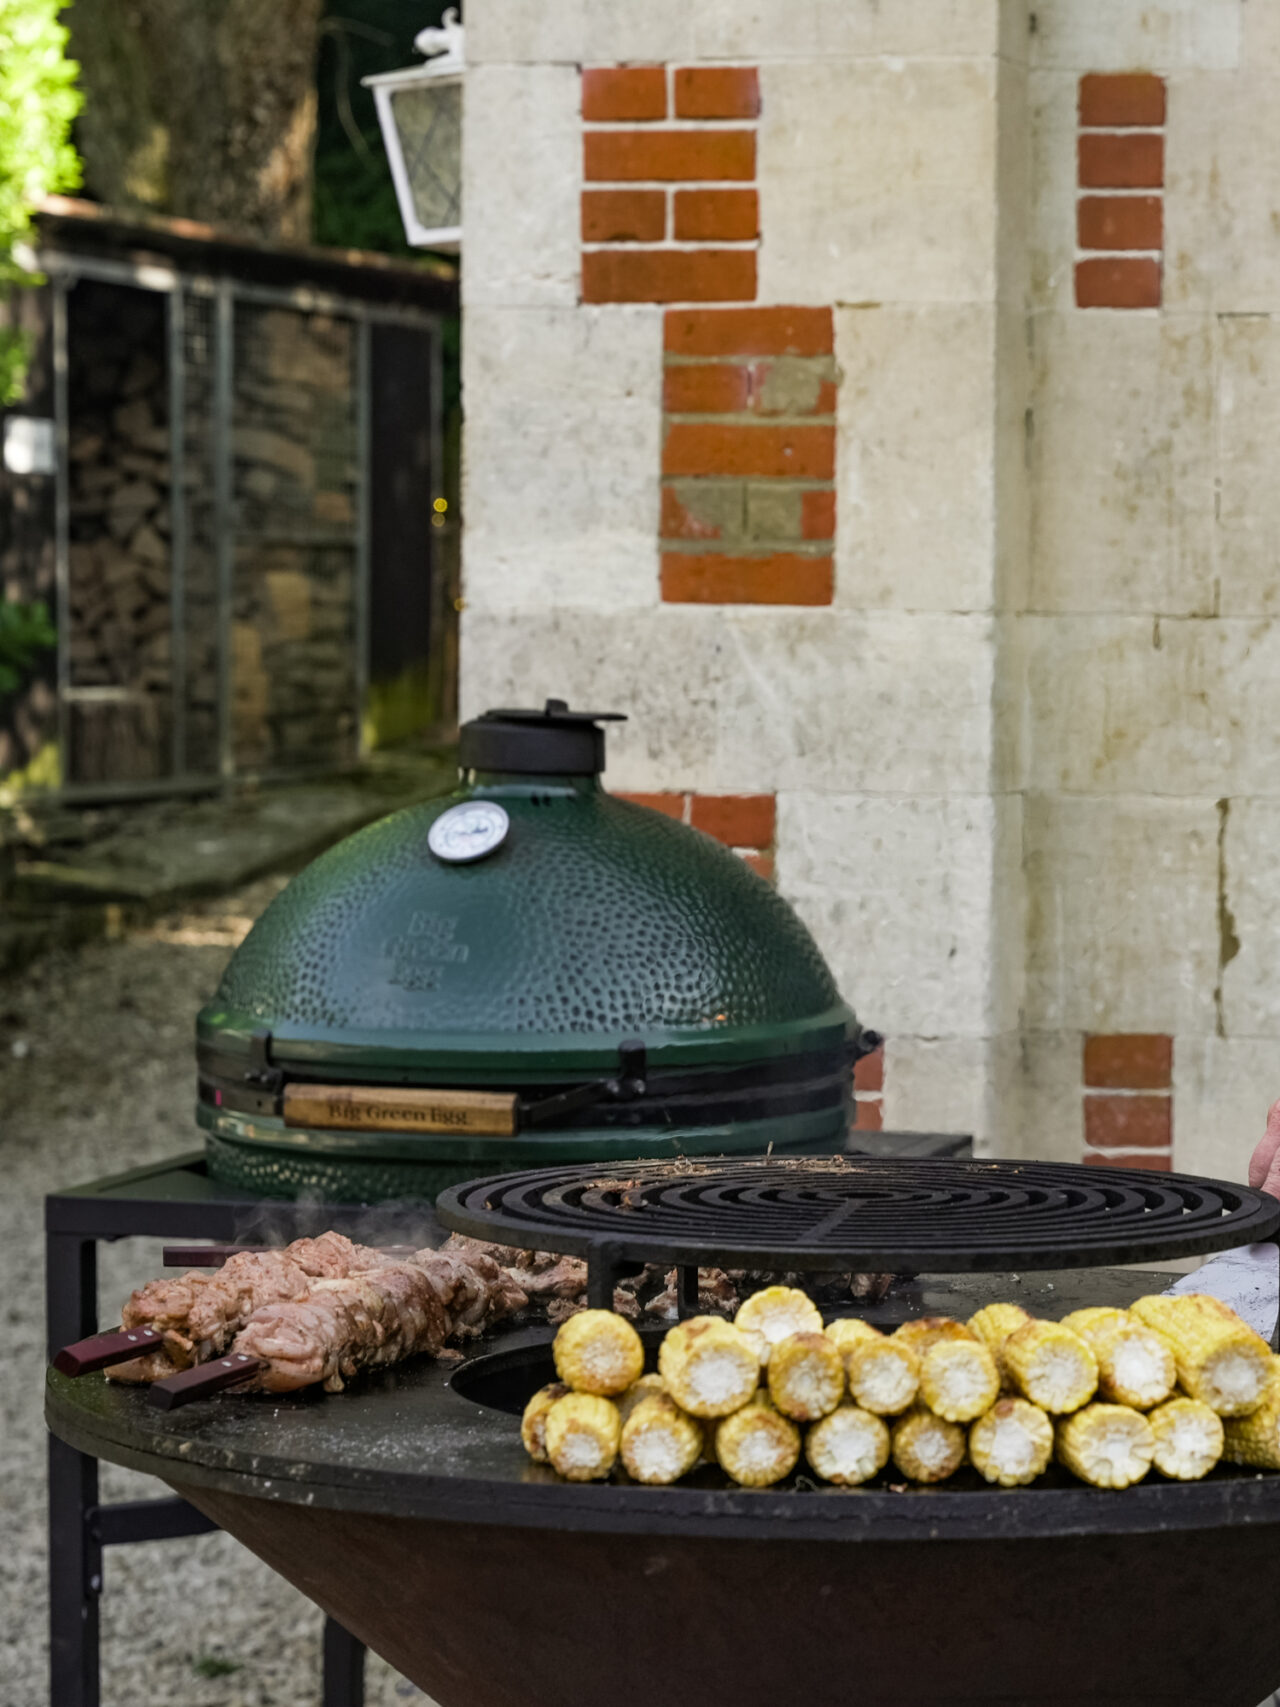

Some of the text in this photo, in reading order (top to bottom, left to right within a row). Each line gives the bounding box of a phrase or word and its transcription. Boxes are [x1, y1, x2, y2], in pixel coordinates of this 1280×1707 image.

[328, 1102, 469, 1125] Big Green Egg
